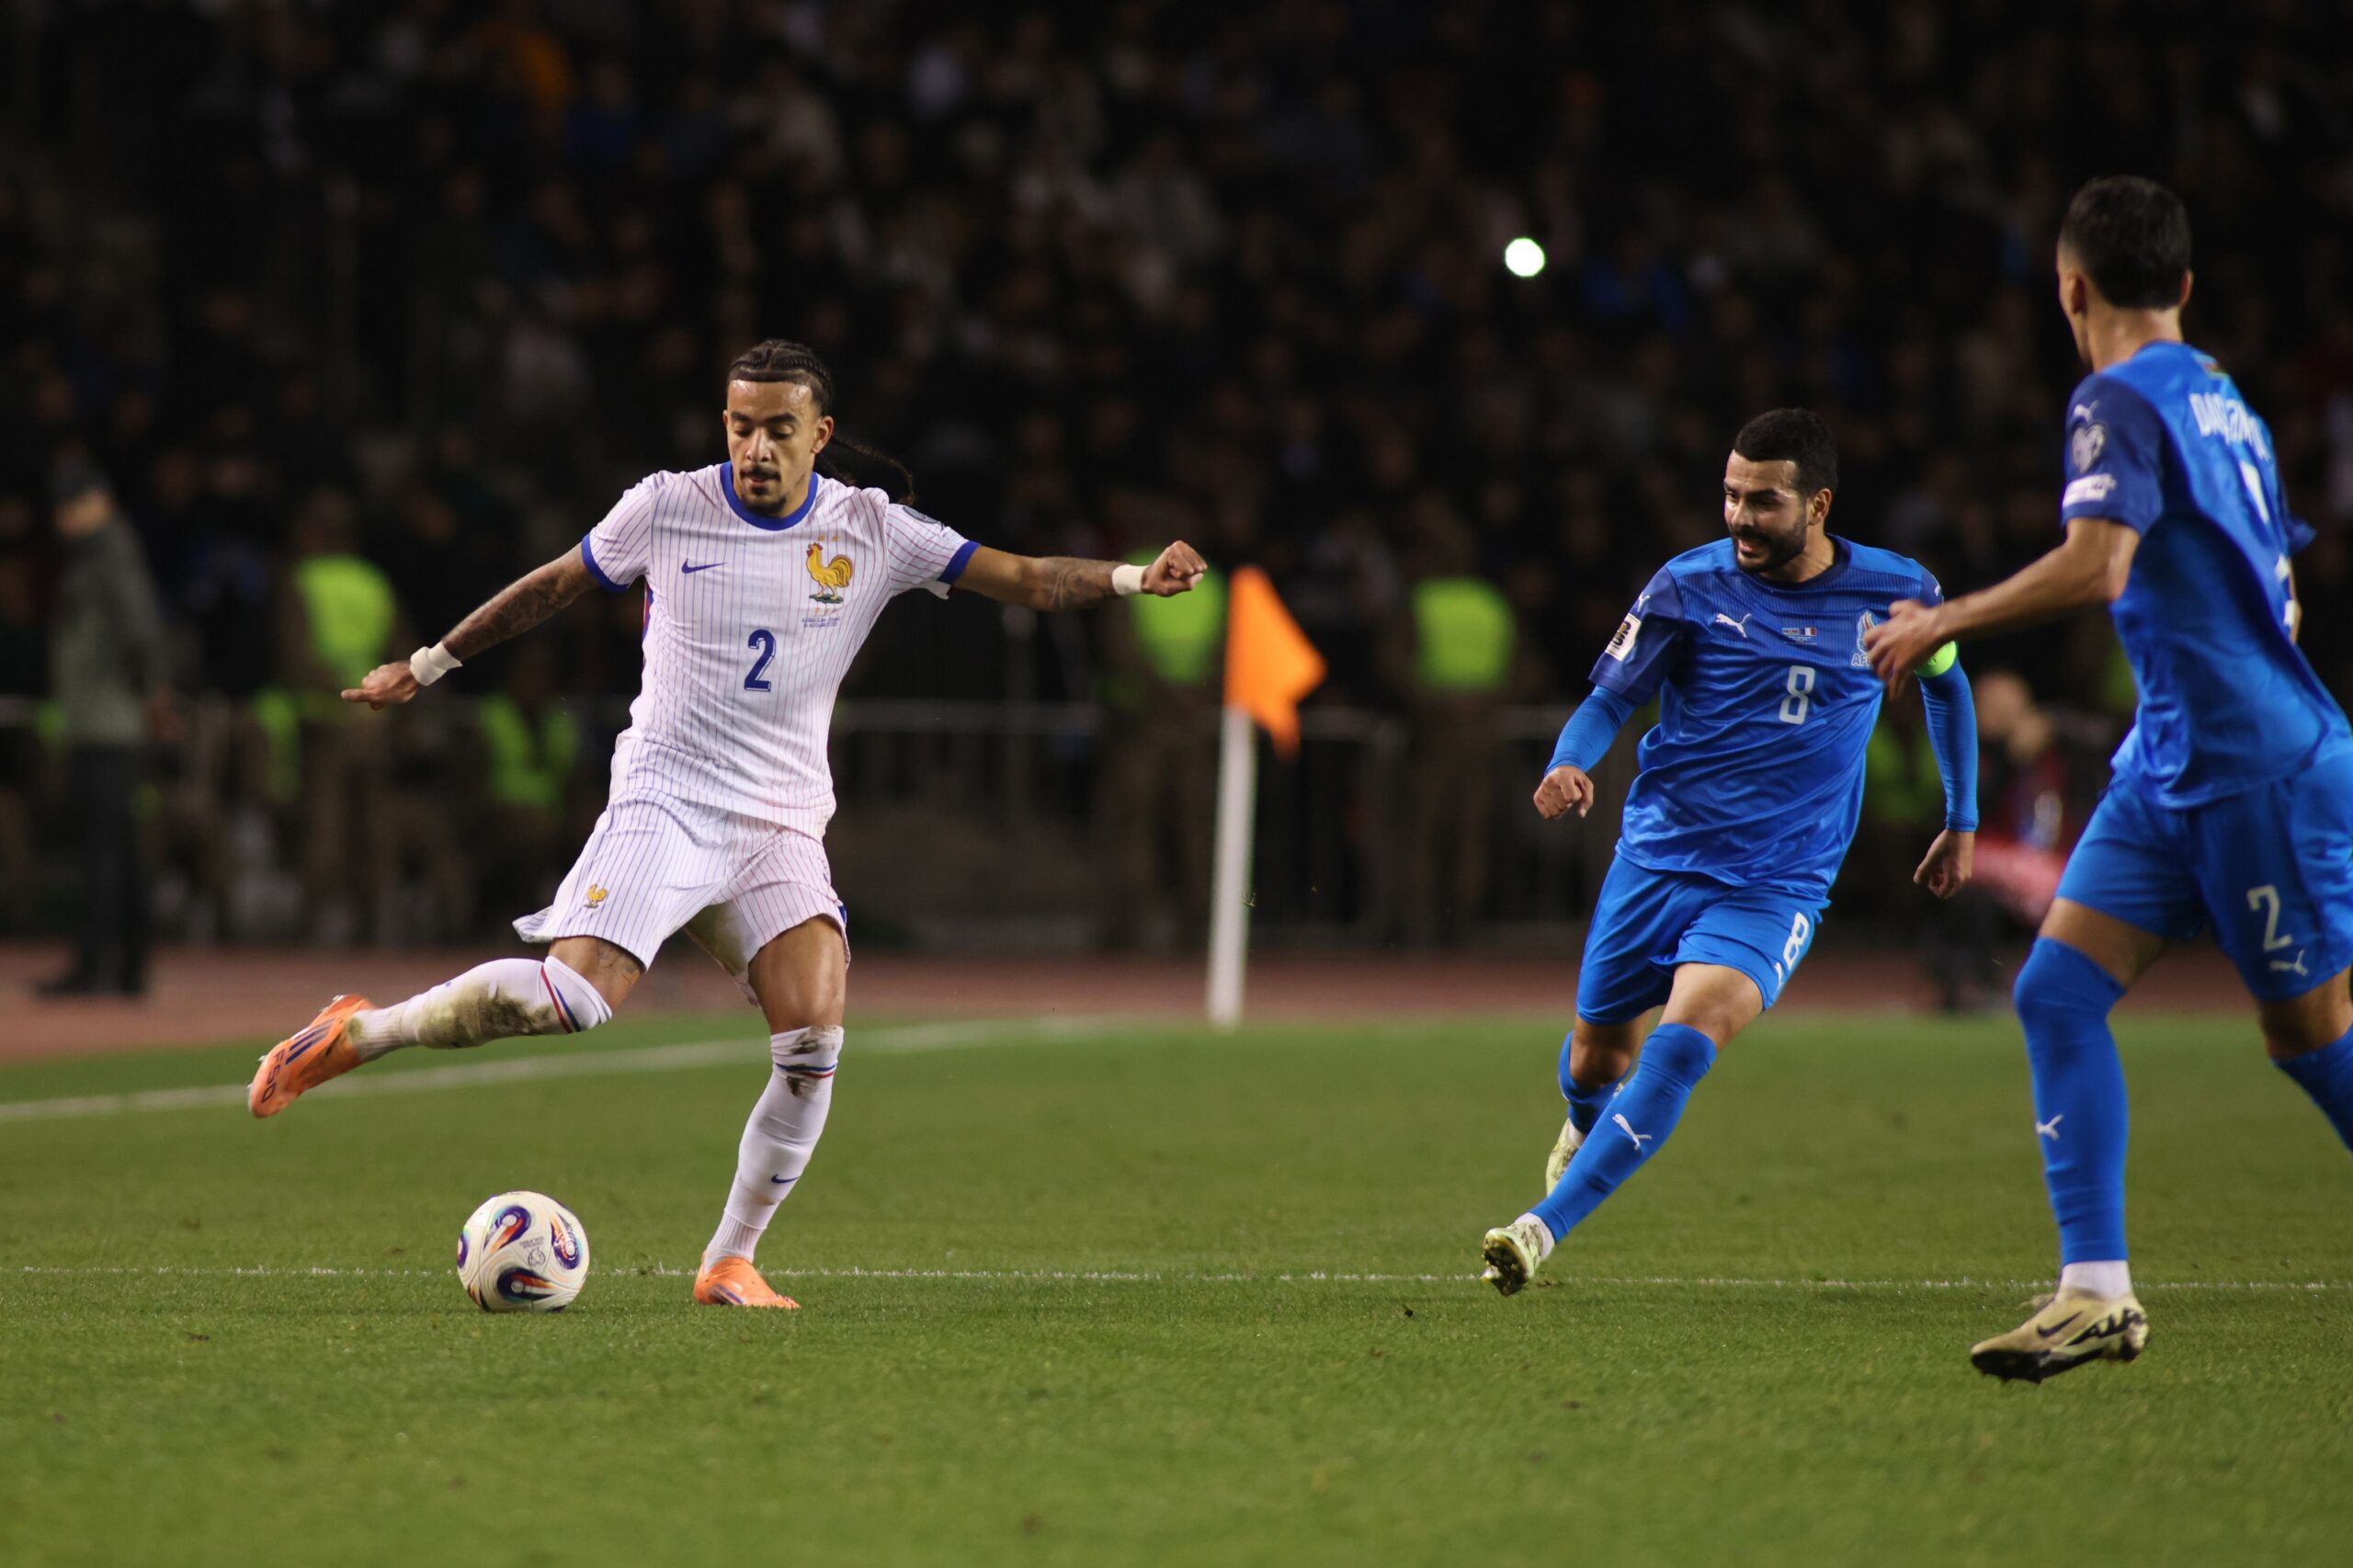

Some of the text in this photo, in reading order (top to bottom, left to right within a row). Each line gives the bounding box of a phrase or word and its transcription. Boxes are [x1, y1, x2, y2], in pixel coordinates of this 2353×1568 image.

[744, 629, 776, 692] 2
[1779, 665, 1815, 725] 8
[1783, 912, 1810, 971] 8
[2246, 884, 2292, 952] 2
